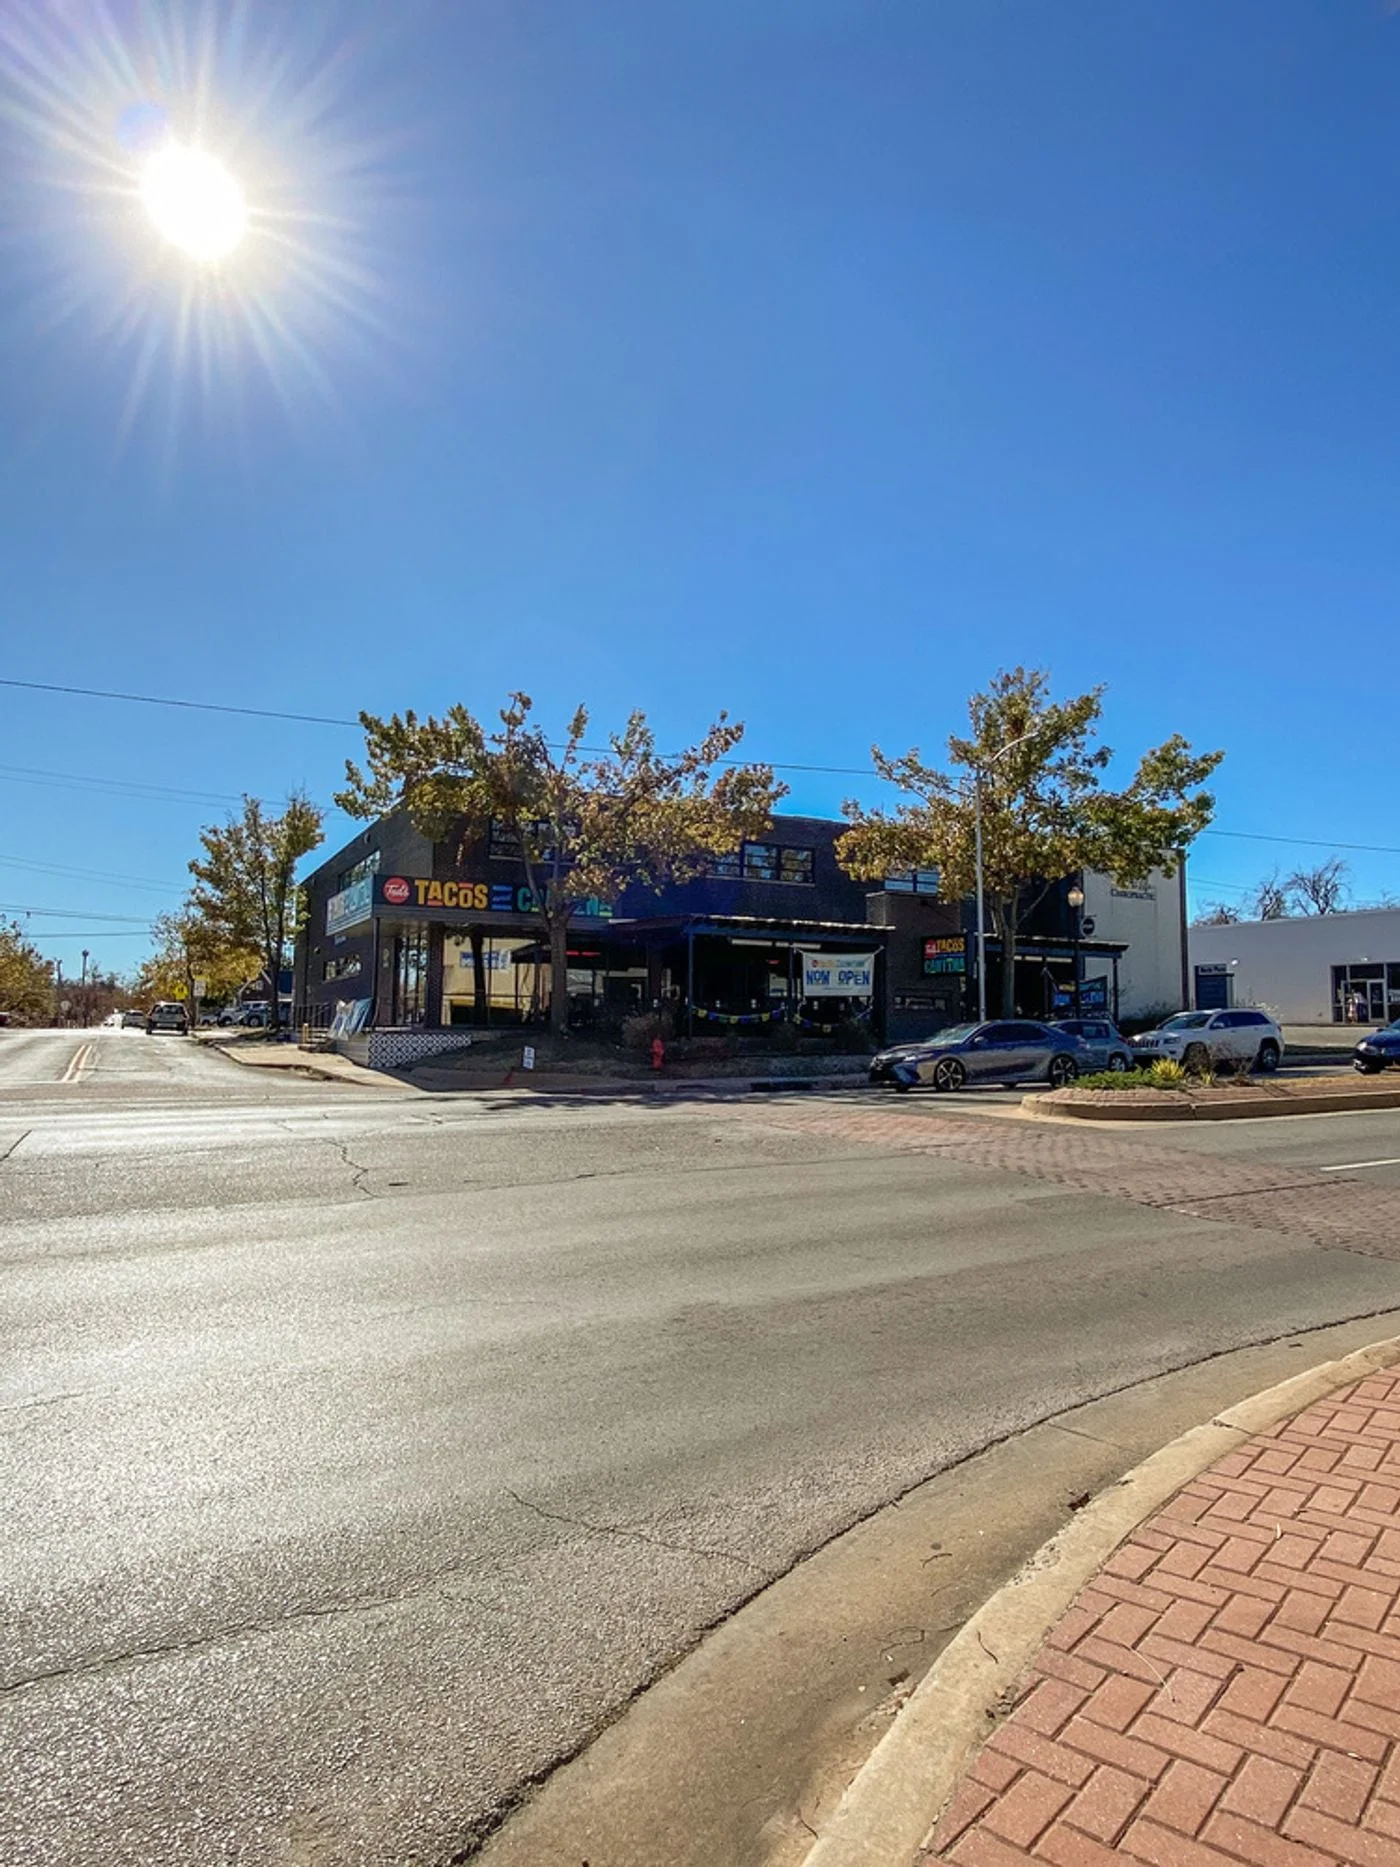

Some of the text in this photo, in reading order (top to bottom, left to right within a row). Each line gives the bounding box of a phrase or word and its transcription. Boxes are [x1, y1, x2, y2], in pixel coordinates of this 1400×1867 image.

[415, 879, 489, 909] TACOS
[936, 938, 965, 952] TACOS
[806, 970, 870, 985] NOW OPEN
